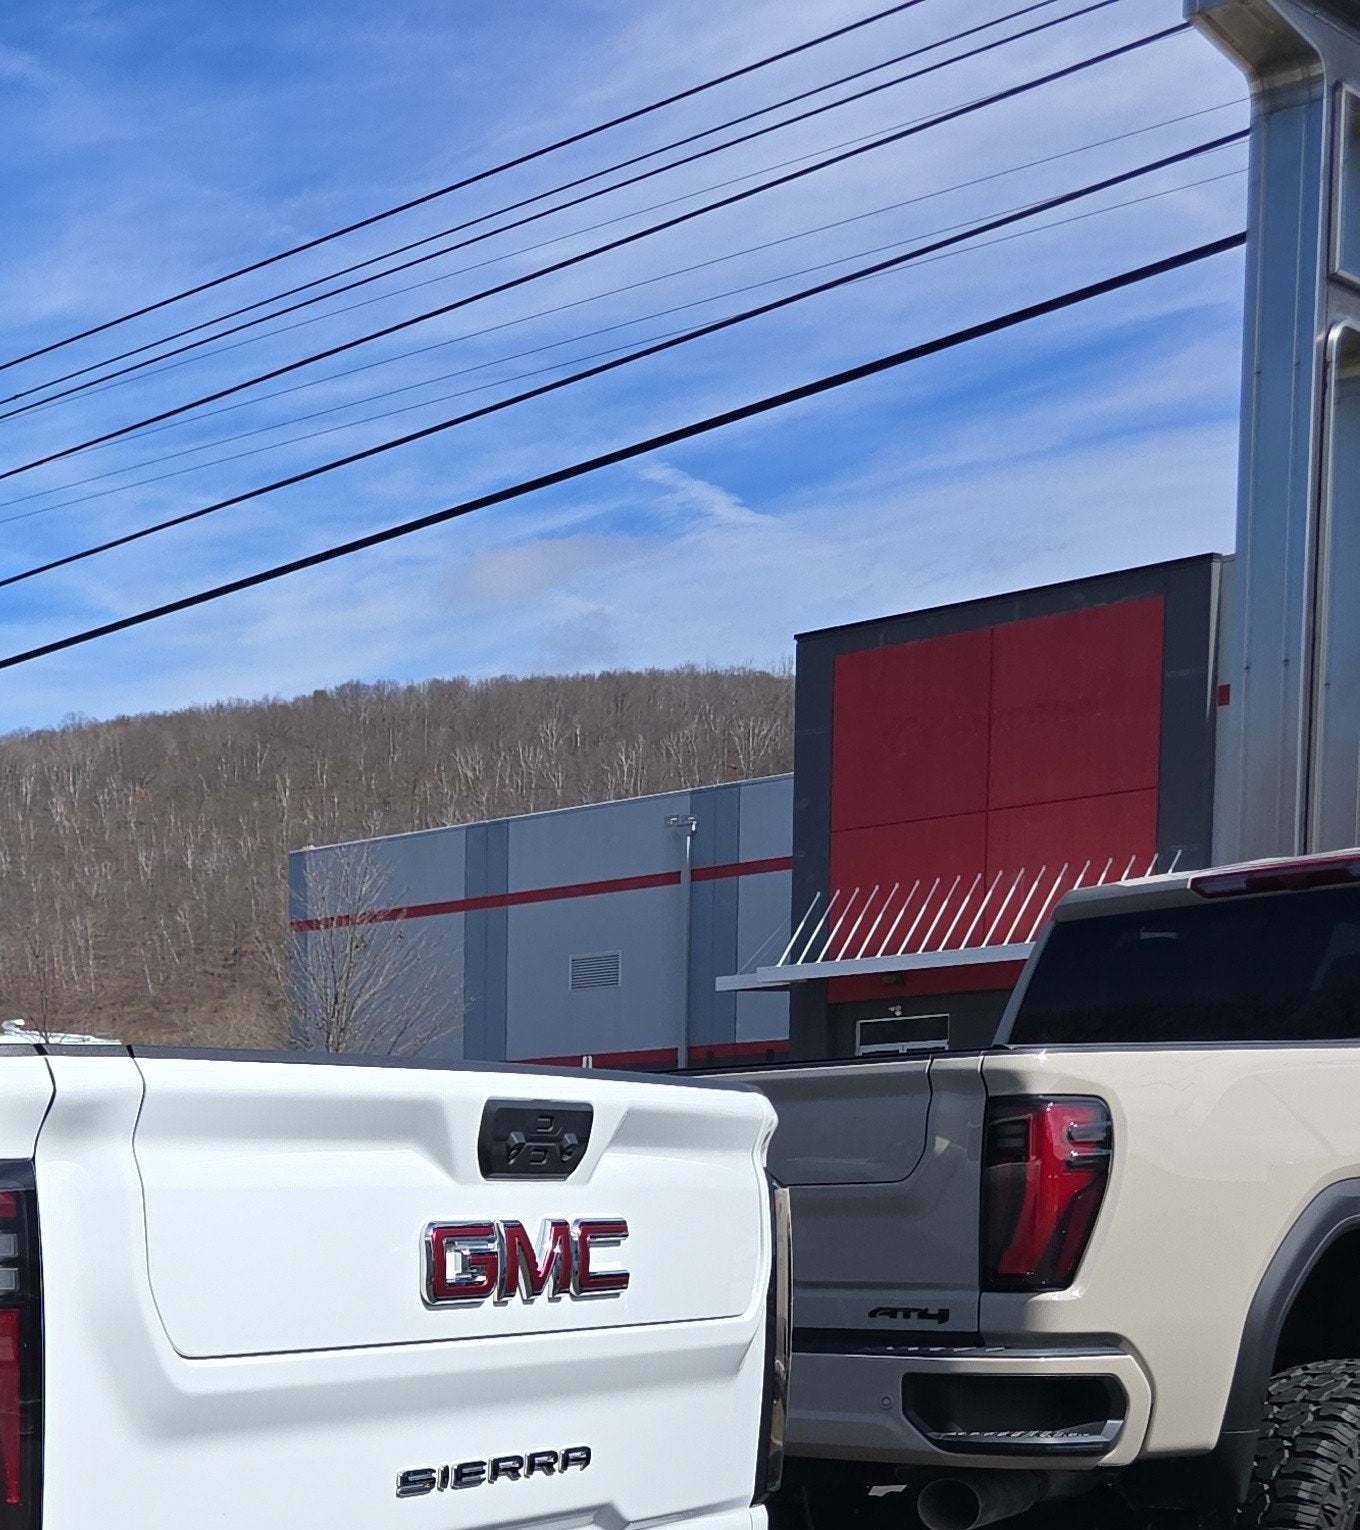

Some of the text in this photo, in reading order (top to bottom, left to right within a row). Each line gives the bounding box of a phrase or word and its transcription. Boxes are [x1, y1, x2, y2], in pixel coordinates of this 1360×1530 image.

[420, 1216, 631, 1310] GMC
[868, 1306, 950, 1324] AT4
[395, 1445, 592, 1498] SIERRA
